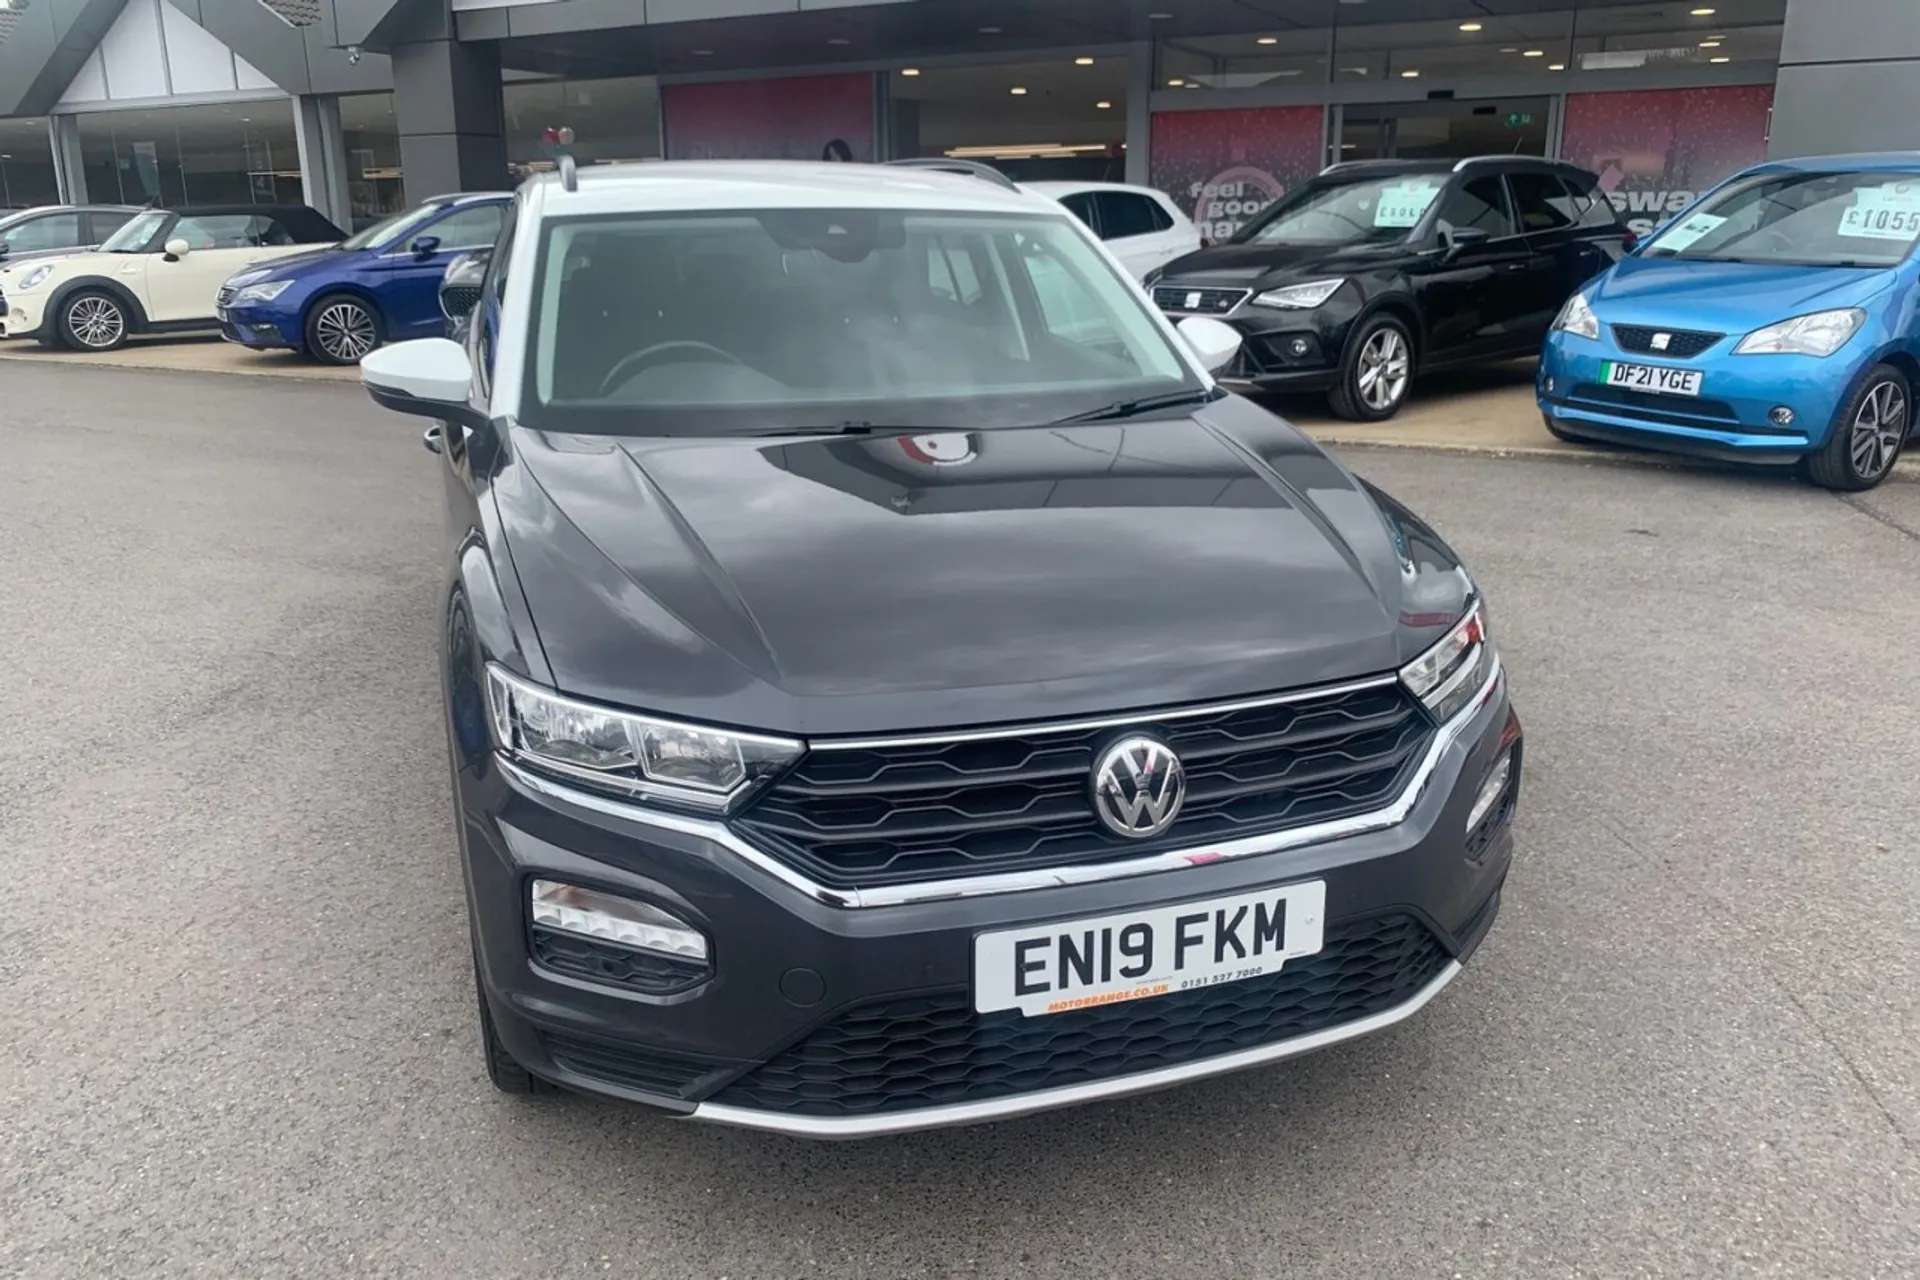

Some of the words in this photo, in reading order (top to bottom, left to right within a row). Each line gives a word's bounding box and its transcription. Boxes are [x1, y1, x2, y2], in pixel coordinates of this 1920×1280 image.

[1190, 181, 1244, 198] feel
[1613, 364, 1653, 385] DF21
[1658, 367, 1696, 391] YGE
[1014, 922, 1154, 998] EN19
[1173, 898, 1288, 971] FKM
